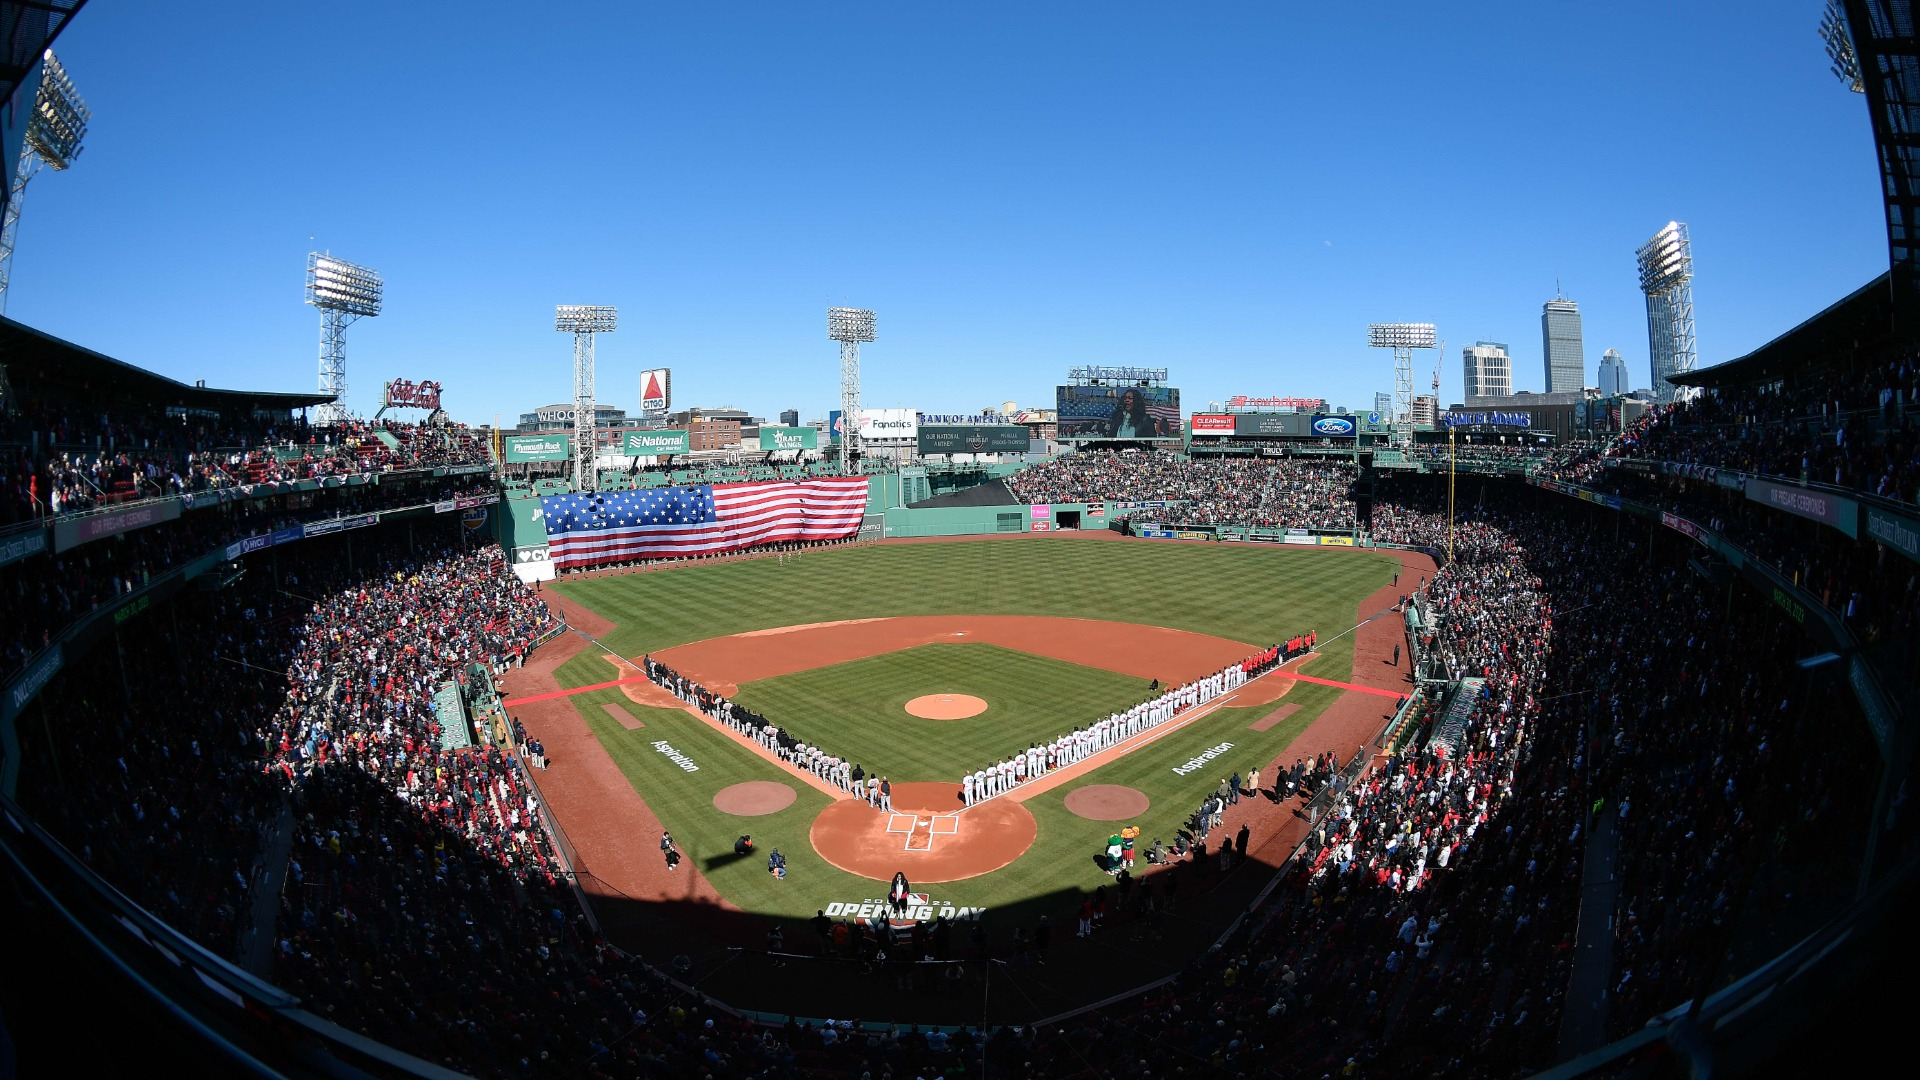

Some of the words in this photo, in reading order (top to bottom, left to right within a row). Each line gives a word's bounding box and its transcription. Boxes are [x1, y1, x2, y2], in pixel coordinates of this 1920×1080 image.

[387, 378, 441, 409] Coca-Cola
[643, 399, 664, 409] CITGO
[1272, 395, 1321, 407] balance
[537, 410, 576, 422] WHOO
[920, 414, 949, 424] BANK
[951, 415, 965, 424] OF
[967, 415, 1011, 424] AMERICA
[1445, 412, 1486, 427] SAMUEL
[1490, 411, 1530, 428] ADAMS
[872, 419, 912, 429] Fanatics
[1321, 421, 1346, 432] Ford
[775, 435, 803, 444] DRAFT
[514, 442, 544, 452] Plymouth
[544, 441, 561, 450] Rock
[1779, 490, 1797, 508] PREGAME
[1798, 493, 1826, 516] CEREMONIES
[463, 509, 486, 520] Gulf
[104, 515, 125, 531] PREGAME
[250, 537, 265, 548] HYCU
[531, 549, 550, 561] CV
[650, 740, 700, 773] Aspiration
[1171, 742, 1236, 776] Aspiration
[938, 905, 987, 921] DAY
